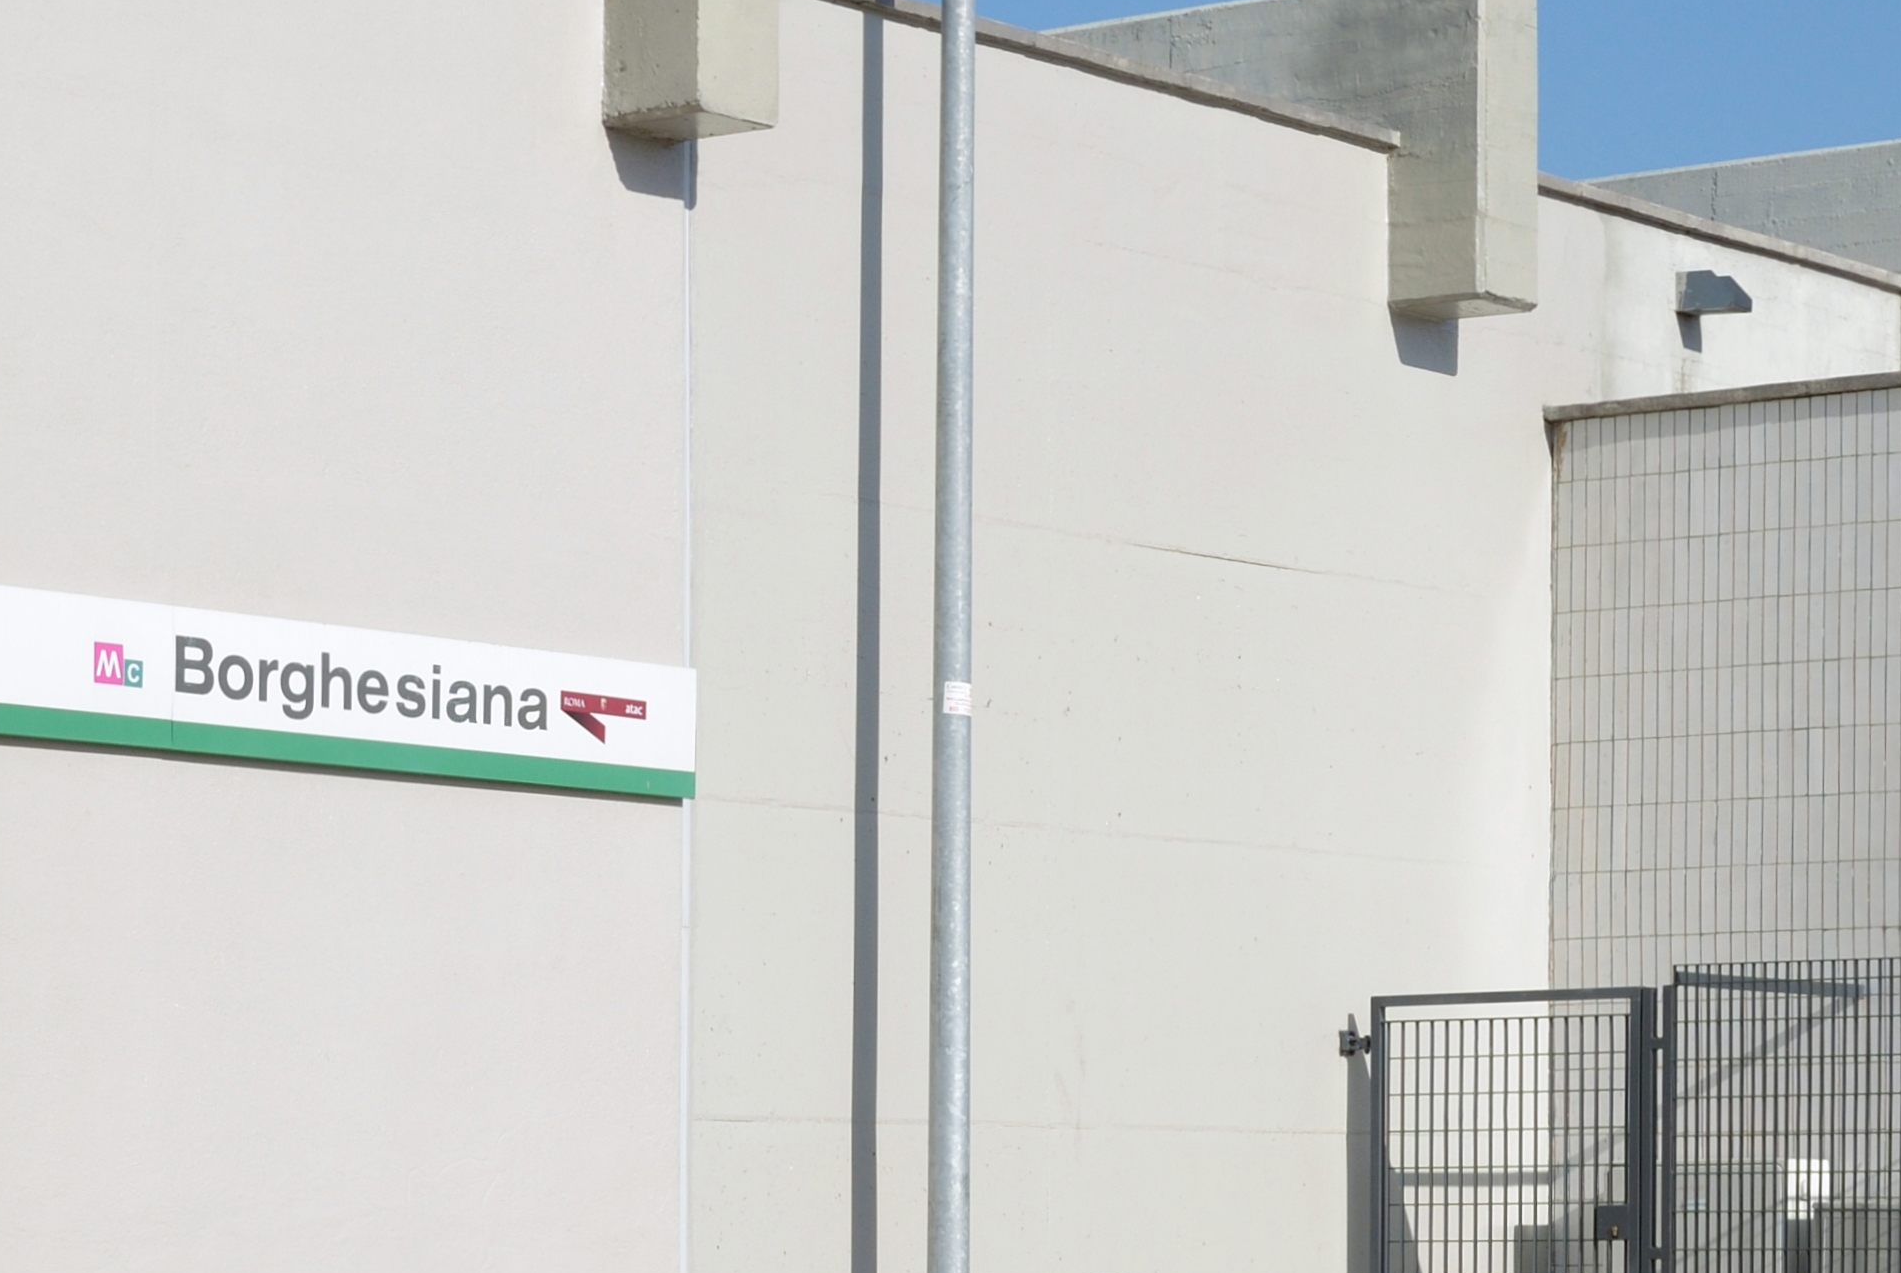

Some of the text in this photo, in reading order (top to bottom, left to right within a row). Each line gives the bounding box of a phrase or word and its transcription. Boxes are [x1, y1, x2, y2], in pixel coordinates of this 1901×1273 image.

[175, 635, 547, 731] Borghesiana
[563, 696, 586, 709] ROMA
[625, 704, 643, 716] atac
